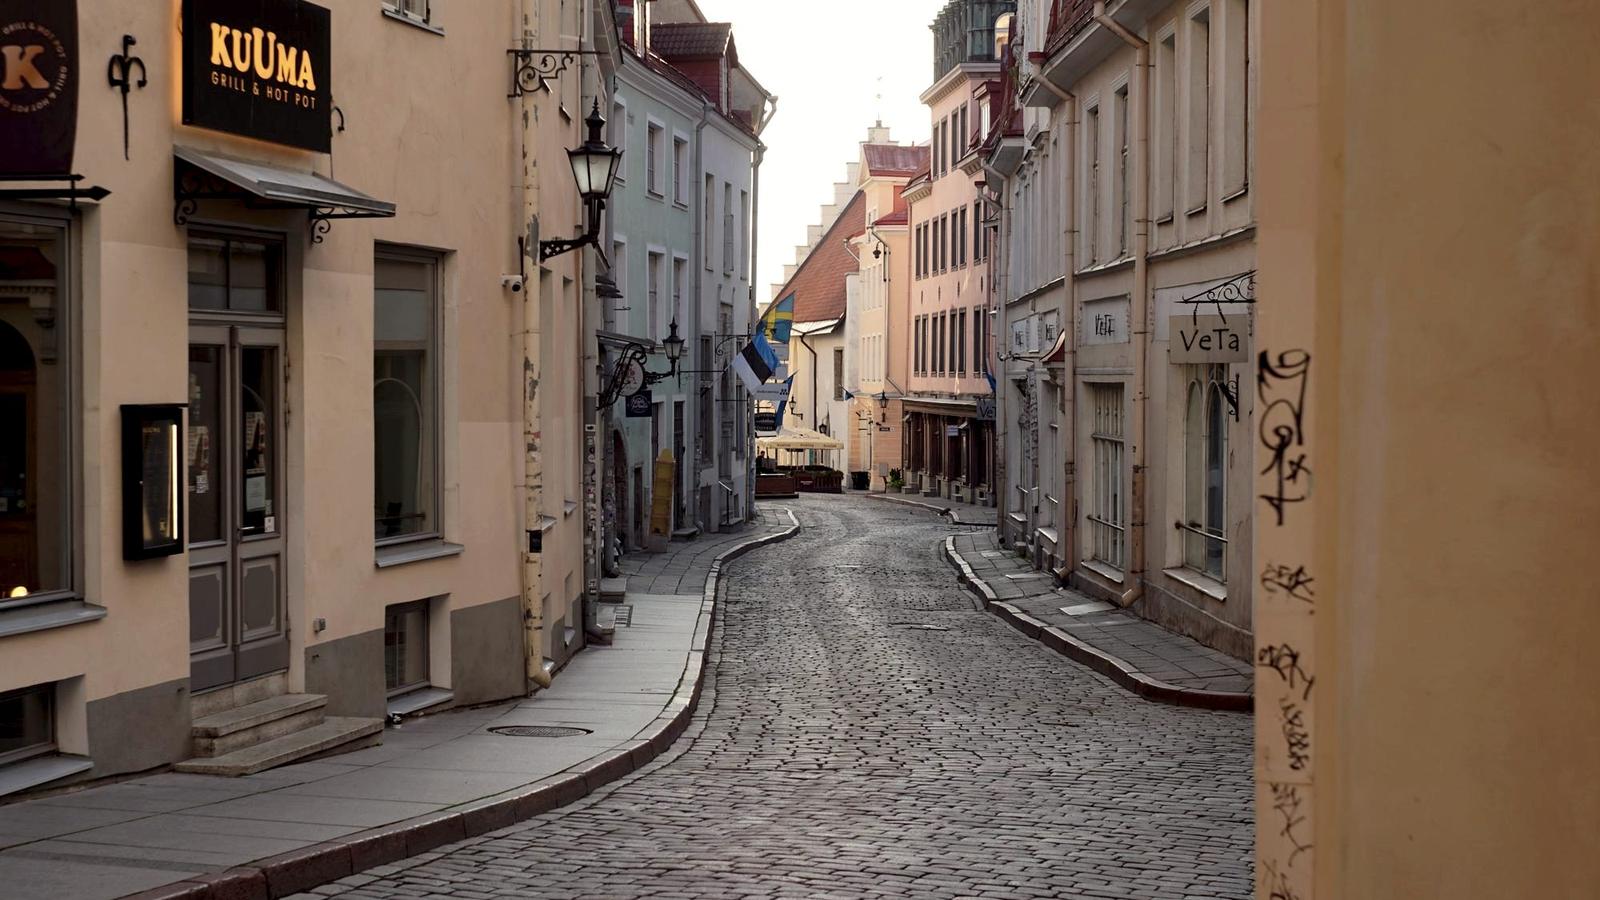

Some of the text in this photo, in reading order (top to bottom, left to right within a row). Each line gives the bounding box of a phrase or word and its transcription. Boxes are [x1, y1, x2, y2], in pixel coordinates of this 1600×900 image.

[1, 45, 50, 90] K
[210, 22, 316, 91] KUUMA
[211, 71, 316, 109] GRILL & HOT POT
[1180, 328, 1239, 352] VeTa
